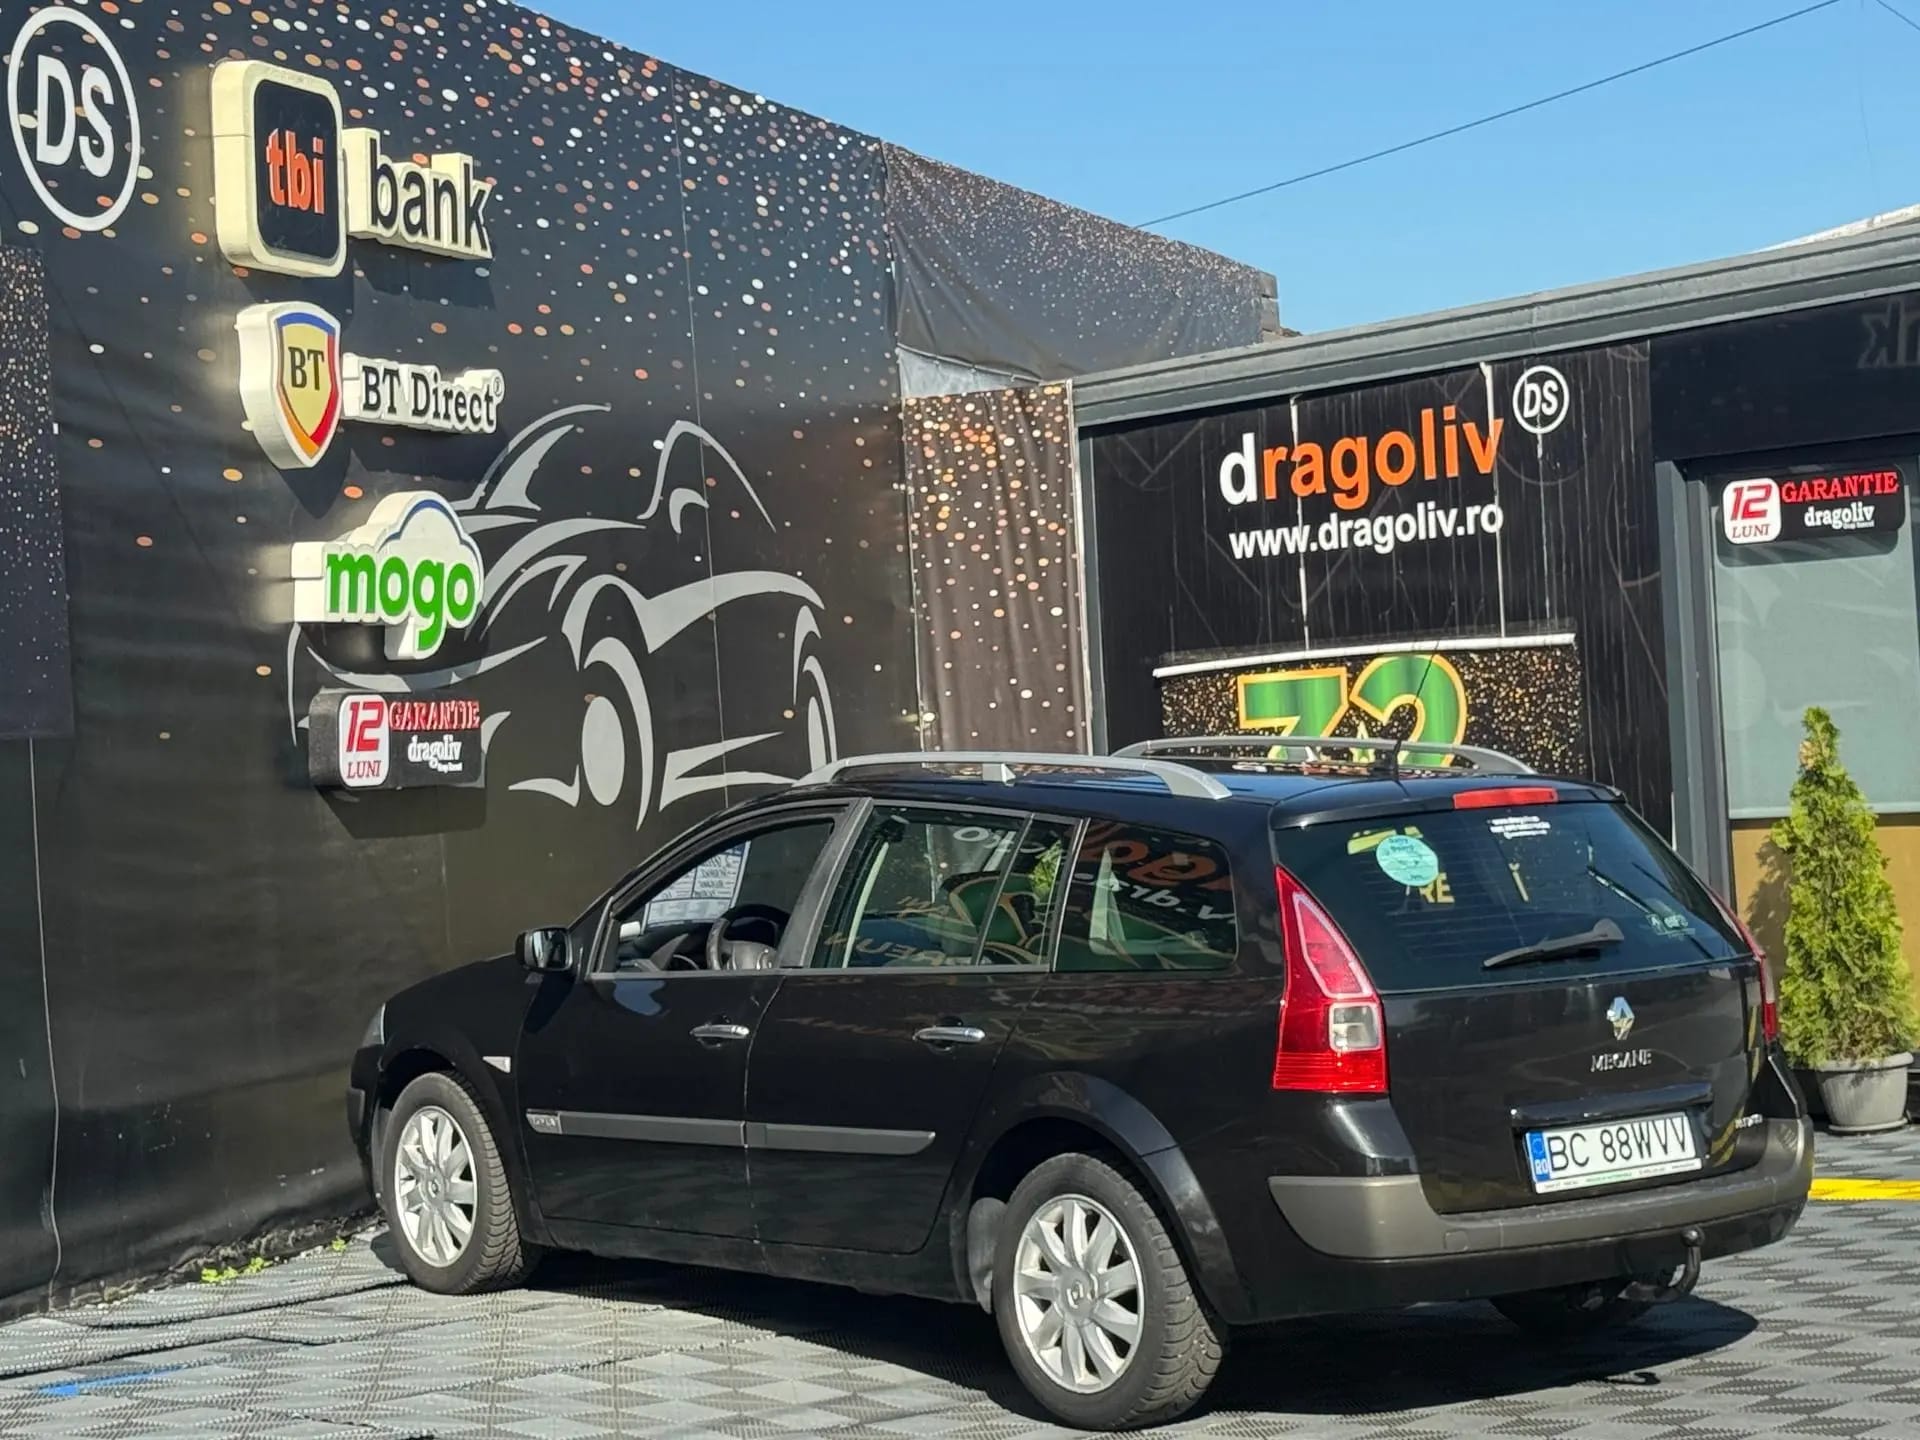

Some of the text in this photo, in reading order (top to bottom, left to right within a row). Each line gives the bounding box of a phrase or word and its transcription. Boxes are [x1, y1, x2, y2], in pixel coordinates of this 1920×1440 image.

[37, 55, 115, 178] DS
[266, 127, 325, 215] tbi
[370, 137, 490, 252] bank
[287, 346, 325, 391] BT
[362, 365, 401, 414] BT
[1523, 380, 1560, 418] DS
[1219, 404, 1504, 511] dragoliv
[1730, 484, 1773, 521] 12
[1781, 472, 1899, 502] GARANTIE
[1229, 500, 1504, 560] www.dragoliv.ro
[1731, 523, 1771, 539] LUNI
[1803, 501, 1875, 530] dragoliv
[328, 552, 475, 651] mogo
[346, 701, 384, 752] 12
[388, 699, 481, 732] GARANTIE
[346, 760, 382, 779] LUNI
[407, 734, 462, 769] dragoliv
[1590, 1048, 1652, 1073] MEGANE
[1547, 1115, 1687, 1172] BC 88WVV
